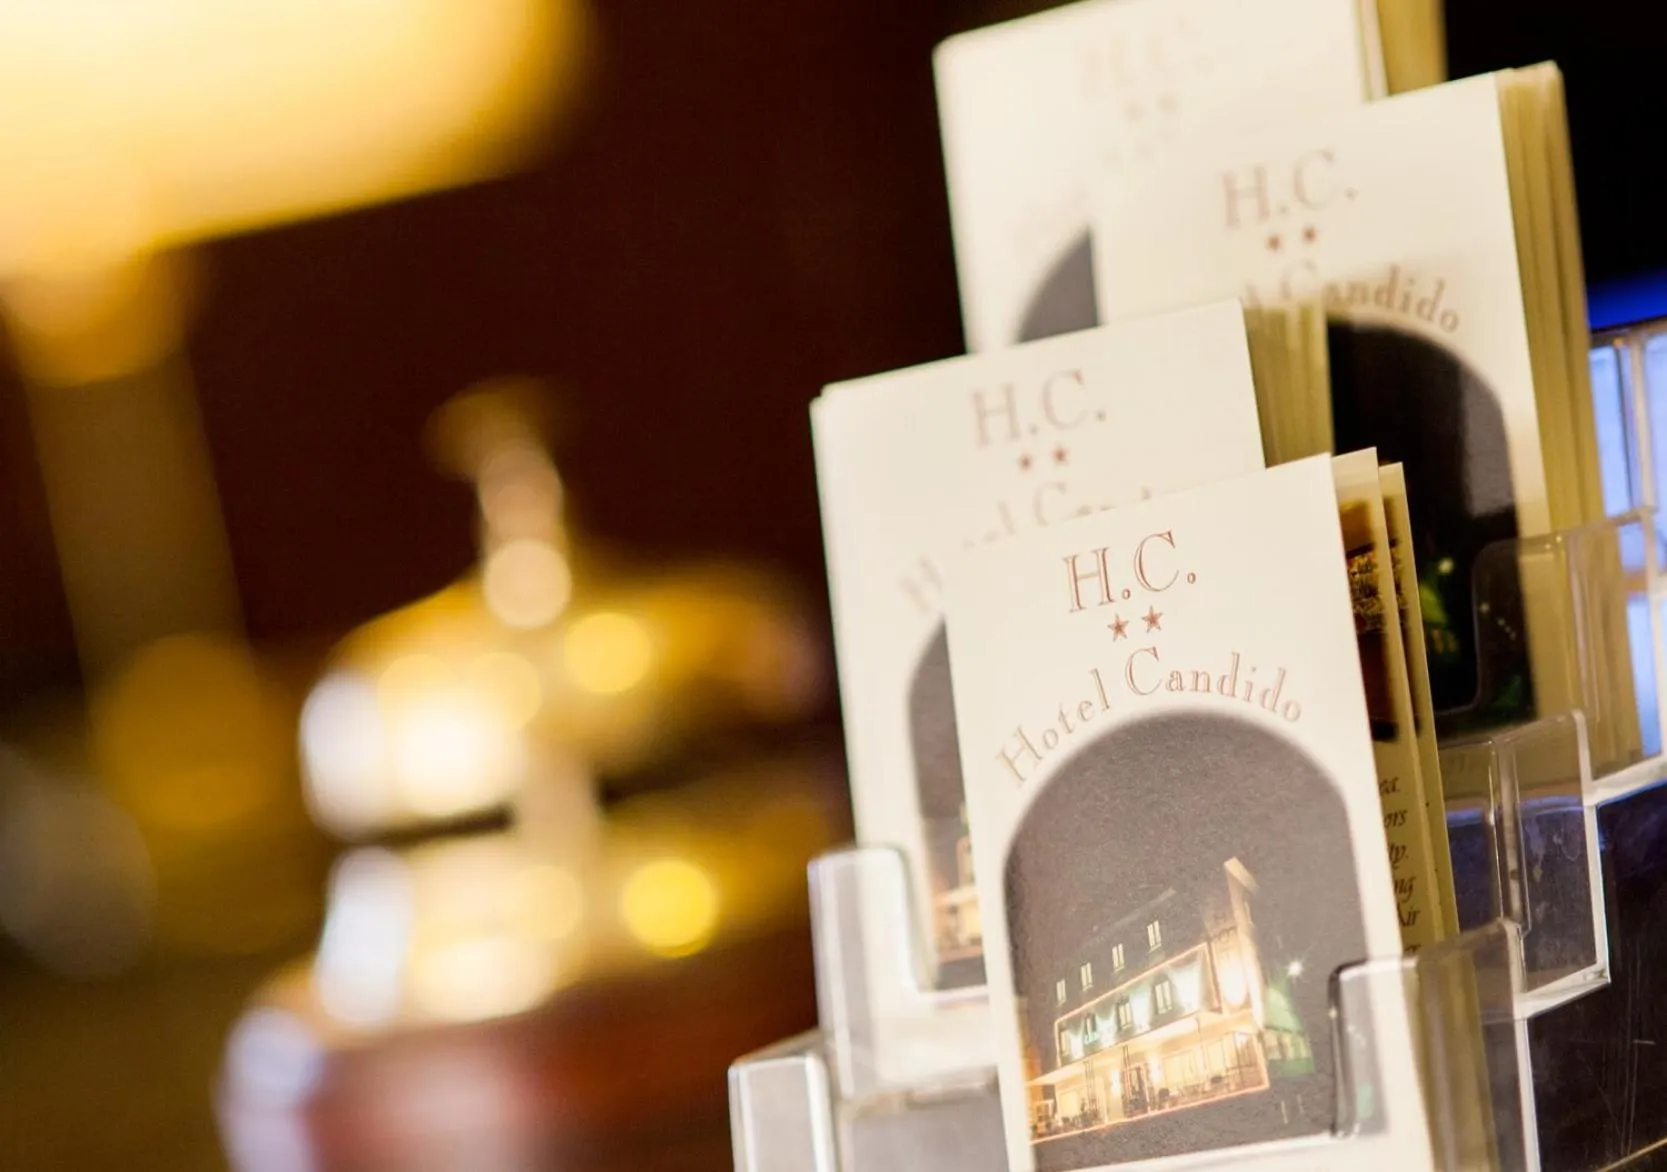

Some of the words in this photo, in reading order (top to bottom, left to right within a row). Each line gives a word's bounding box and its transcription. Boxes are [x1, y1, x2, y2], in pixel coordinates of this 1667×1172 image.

[1221, 148, 1357, 230] H.C.
[969, 368, 1107, 448] H.C.
[1062, 529, 1197, 614] H.C.
[994, 667, 1111, 789] Hotel
[1124, 646, 1303, 724] Candido
